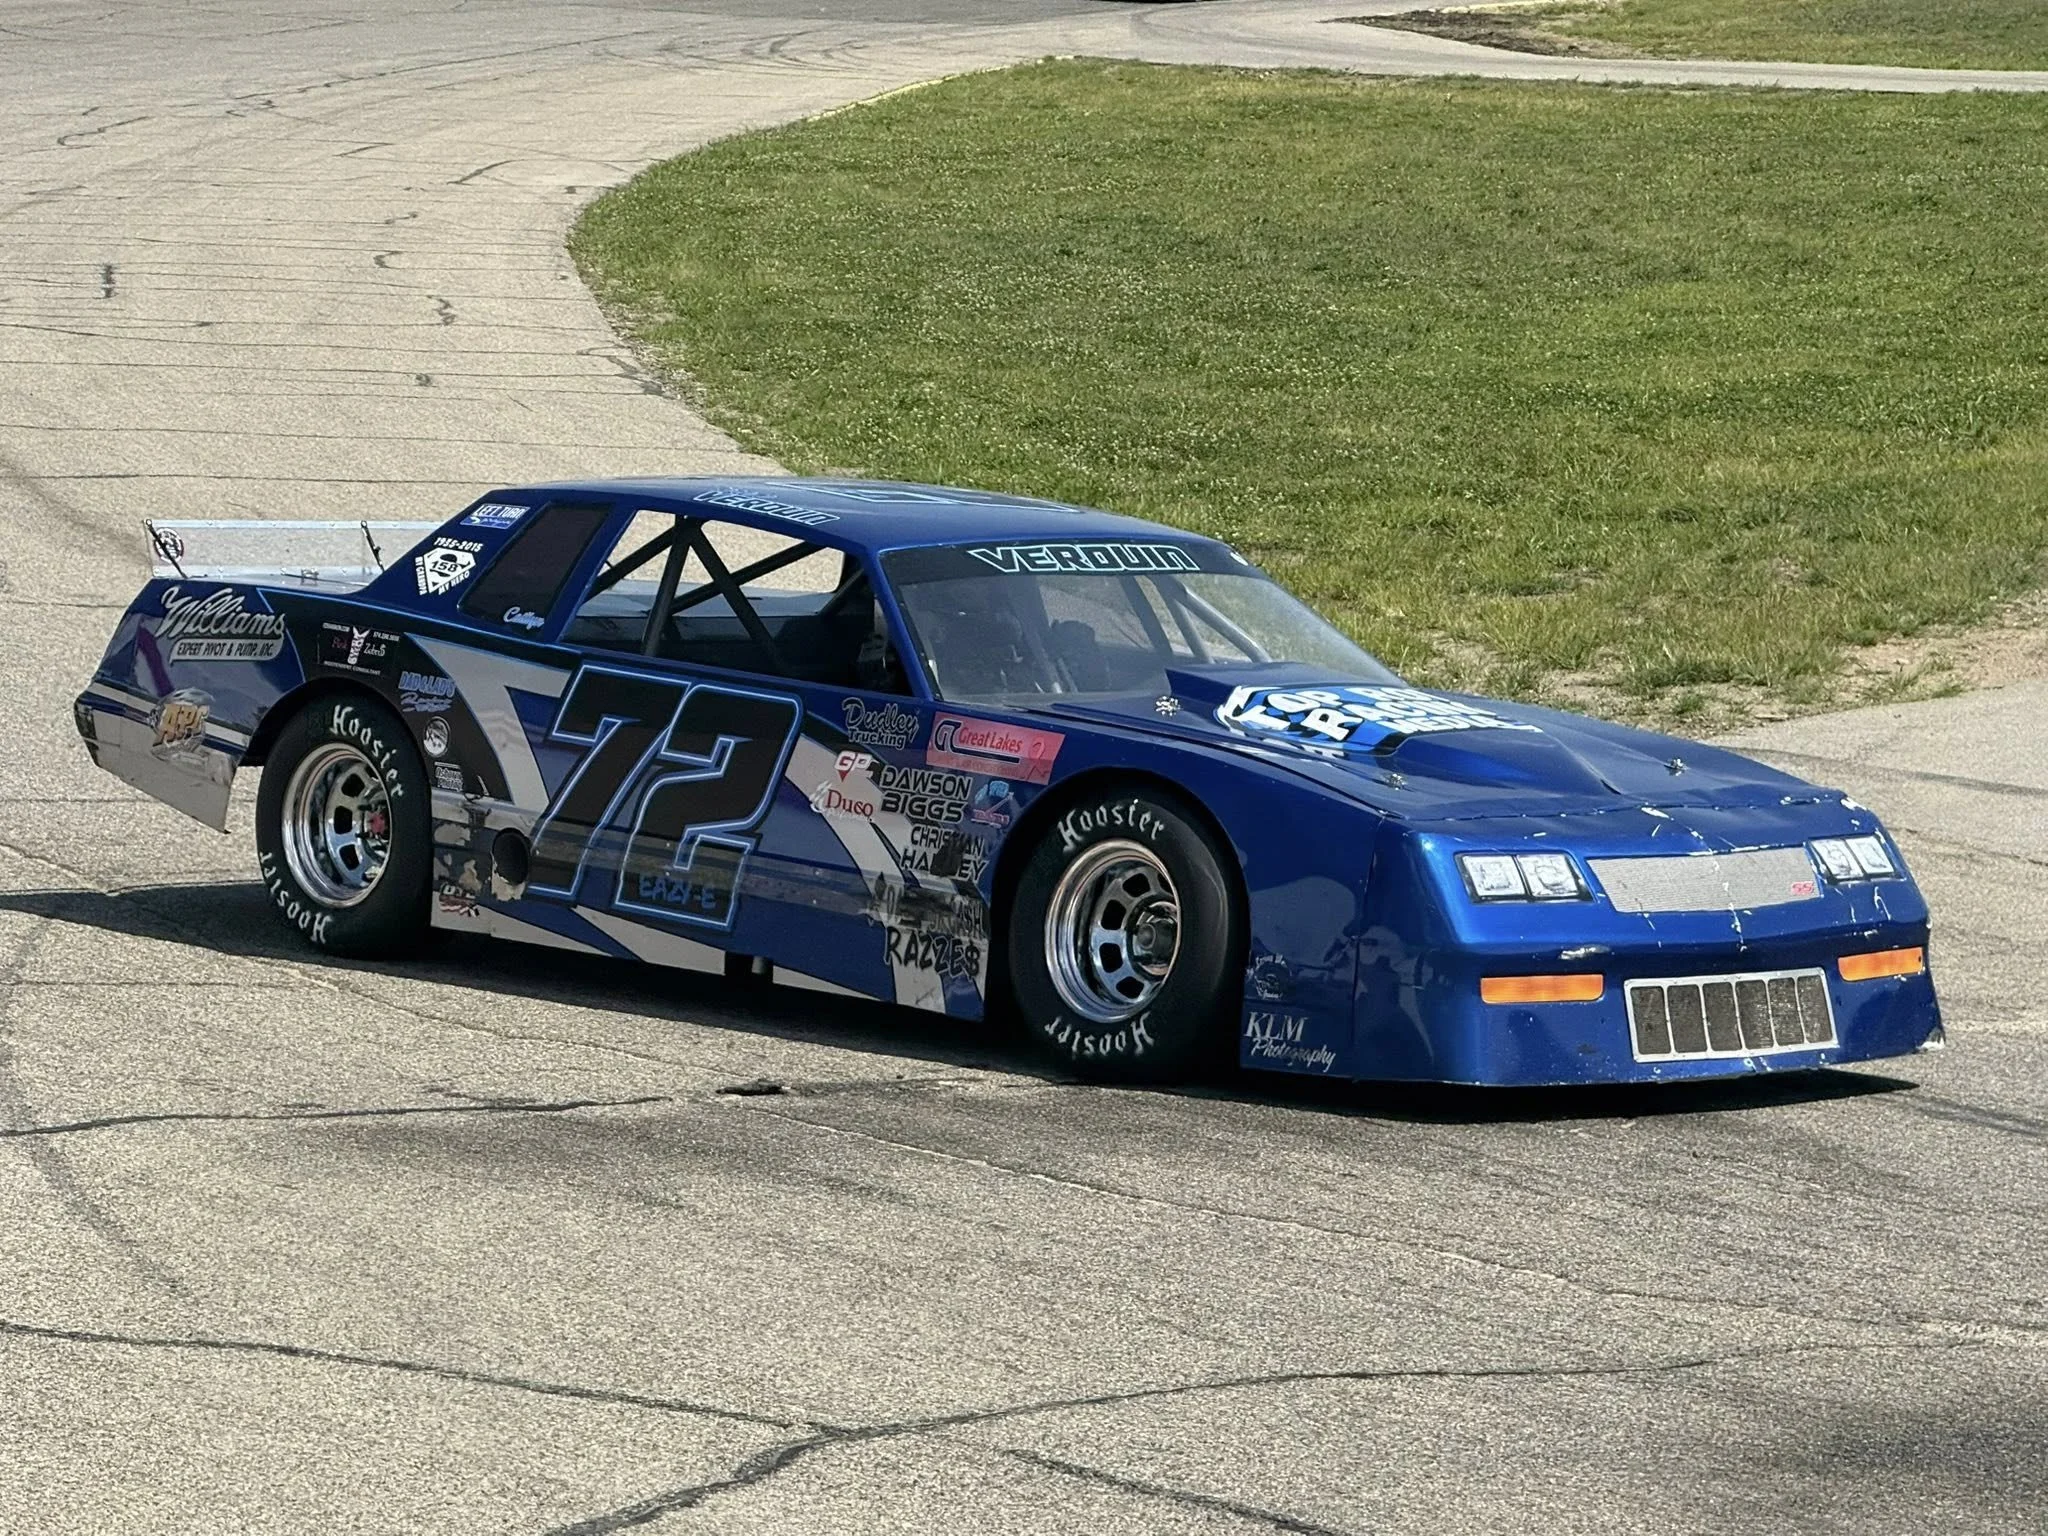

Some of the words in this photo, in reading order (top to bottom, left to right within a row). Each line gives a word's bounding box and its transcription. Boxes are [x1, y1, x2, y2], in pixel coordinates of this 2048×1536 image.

[431, 560, 459, 573] 158
[154, 585, 286, 638] Williams
[202, 642, 225, 657] PIVOT
[842, 697, 920, 743] Dudley
[329, 704, 404, 797] Hoosier
[847, 726, 907, 751] Trucking
[958, 726, 991, 748] Great
[990, 731, 1023, 754] Lakes
[526, 660, 802, 932] 72
[880, 765, 974, 801] DAWSON
[880, 789, 968, 823] BIGGS
[1057, 799, 1165, 853] Hoosier
[900, 848, 990, 882] HAEY
[259, 849, 333, 944] Hoosier
[1791, 881, 1814, 896] SS
[1044, 1011, 1155, 1054] Hoosier
[1244, 1011, 1310, 1042] KLM
[1250, 1036, 1337, 1073] Photography
